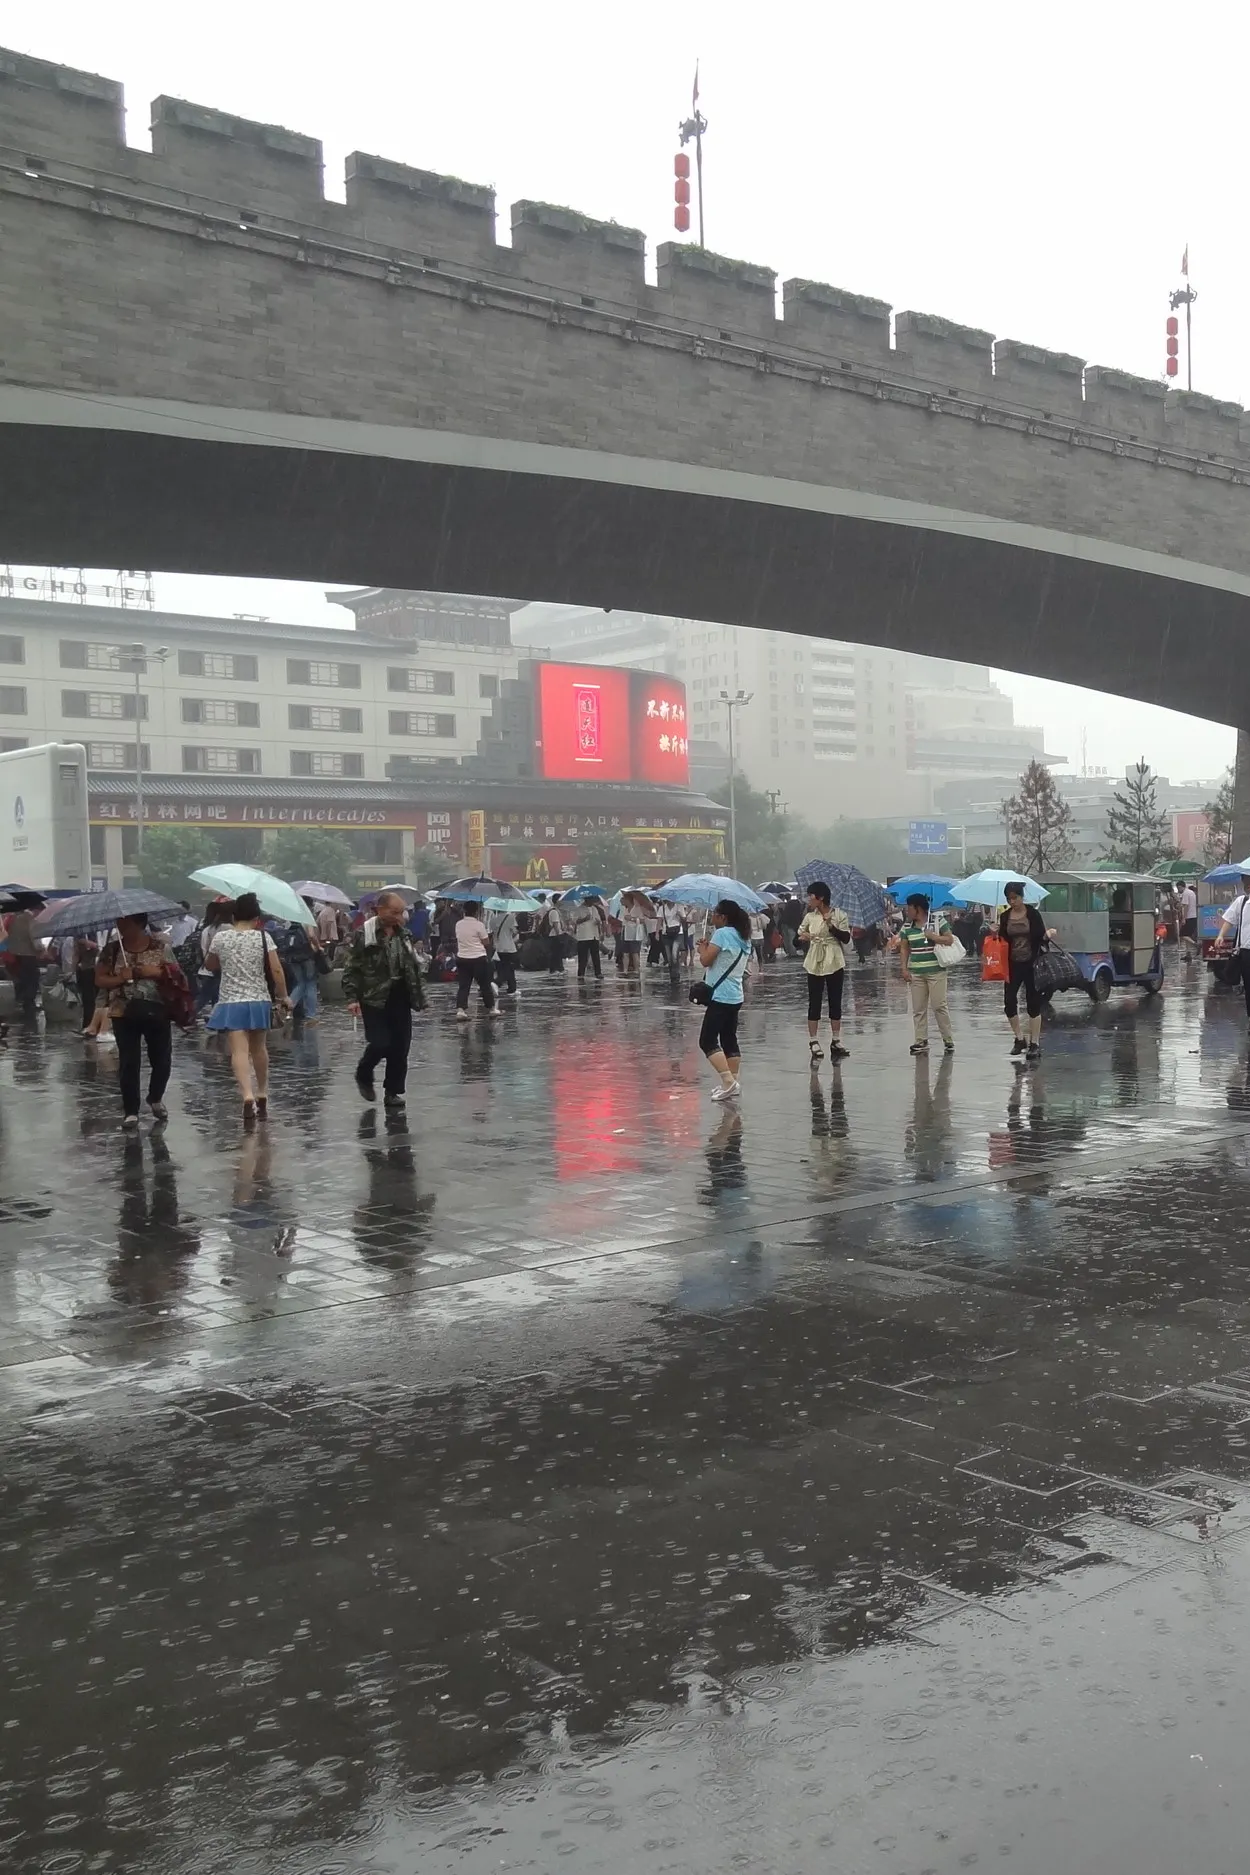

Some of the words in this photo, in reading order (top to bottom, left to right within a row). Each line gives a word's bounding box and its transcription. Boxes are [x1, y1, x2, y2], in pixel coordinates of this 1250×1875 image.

[100, 803, 228, 820] 红树林网吧
[427, 812, 451, 843] 网吧
[585, 816, 620, 828] 入口处
[484, 824, 578, 838] 树林网吧
